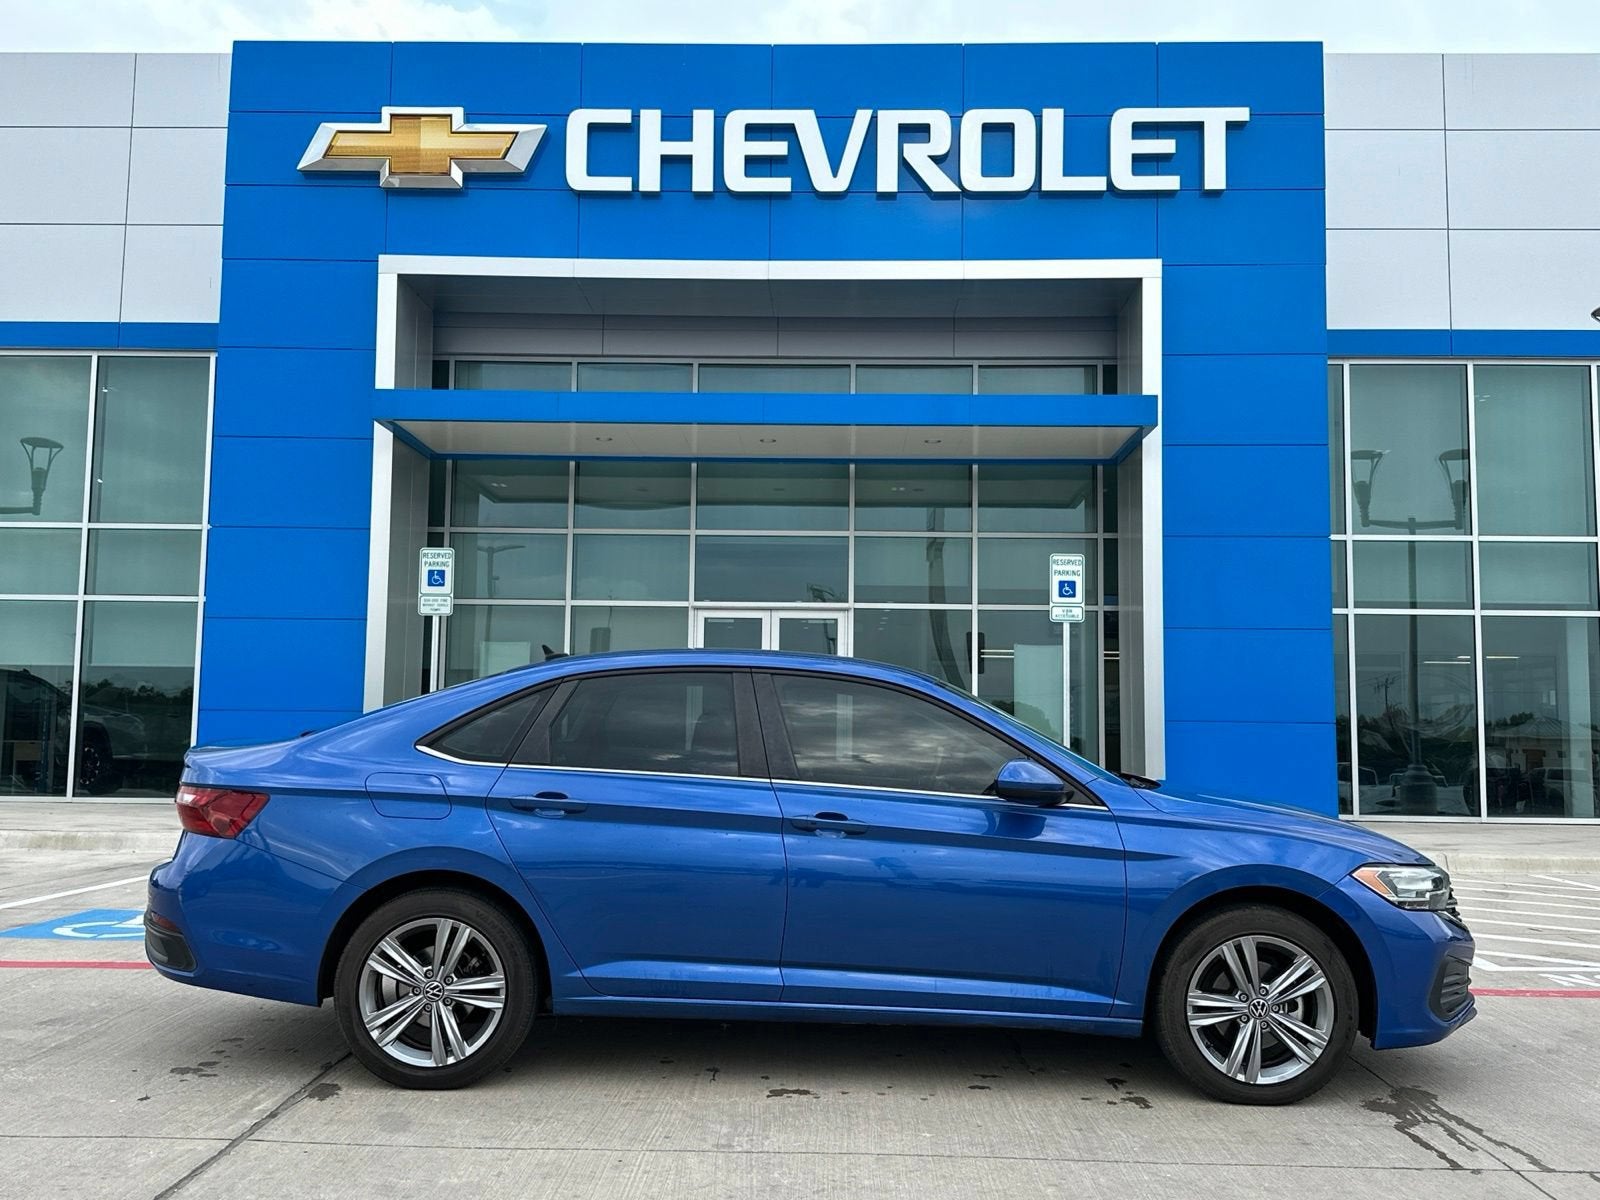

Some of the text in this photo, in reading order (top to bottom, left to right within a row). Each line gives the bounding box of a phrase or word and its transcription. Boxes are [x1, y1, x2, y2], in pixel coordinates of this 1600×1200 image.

[565, 107, 1250, 193] CHEVROLET
[422, 552, 452, 560] RESERVED
[424, 560, 450, 568] PARKING
[1052, 558, 1082, 566] RESERVED
[1053, 569, 1081, 577] PARKING
